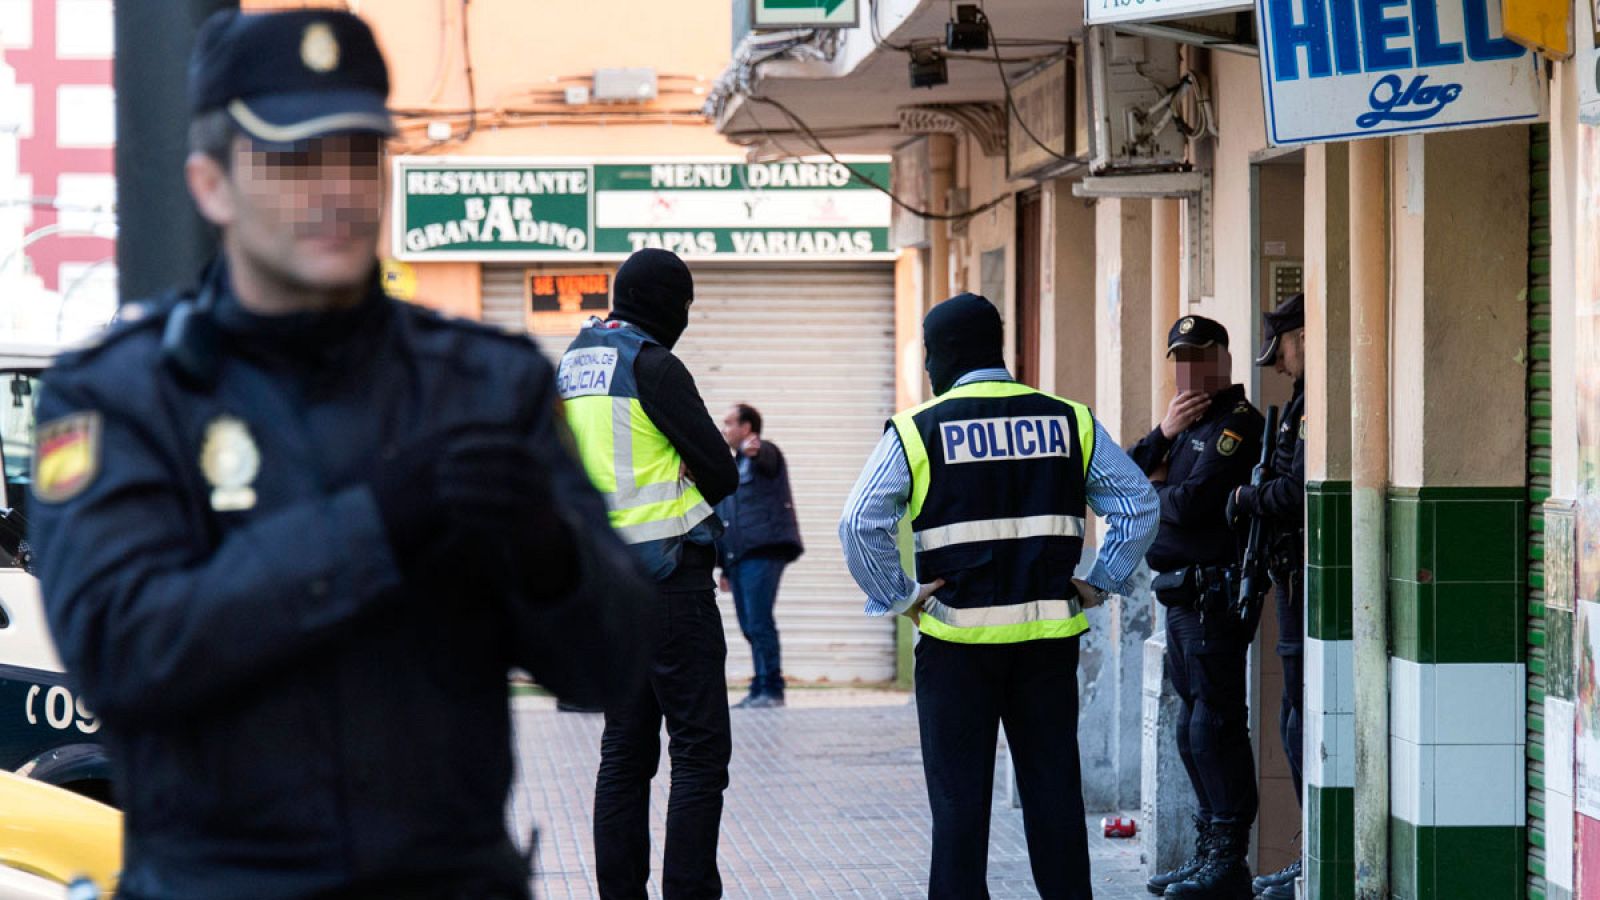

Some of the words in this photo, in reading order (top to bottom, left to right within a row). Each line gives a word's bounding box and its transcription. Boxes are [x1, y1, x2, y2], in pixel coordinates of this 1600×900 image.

[406, 171, 587, 195] RESTAURANTE
[650, 163, 732, 188] MENU
[464, 195, 534, 241] BAR
[742, 195, 769, 220] Y
[406, 217, 586, 252] GRANADINO
[627, 231, 717, 254] TAPAS
[730, 231, 874, 254] VARIADAS
[559, 370, 606, 393] OLICIA
[943, 419, 1067, 461] POLICIA
